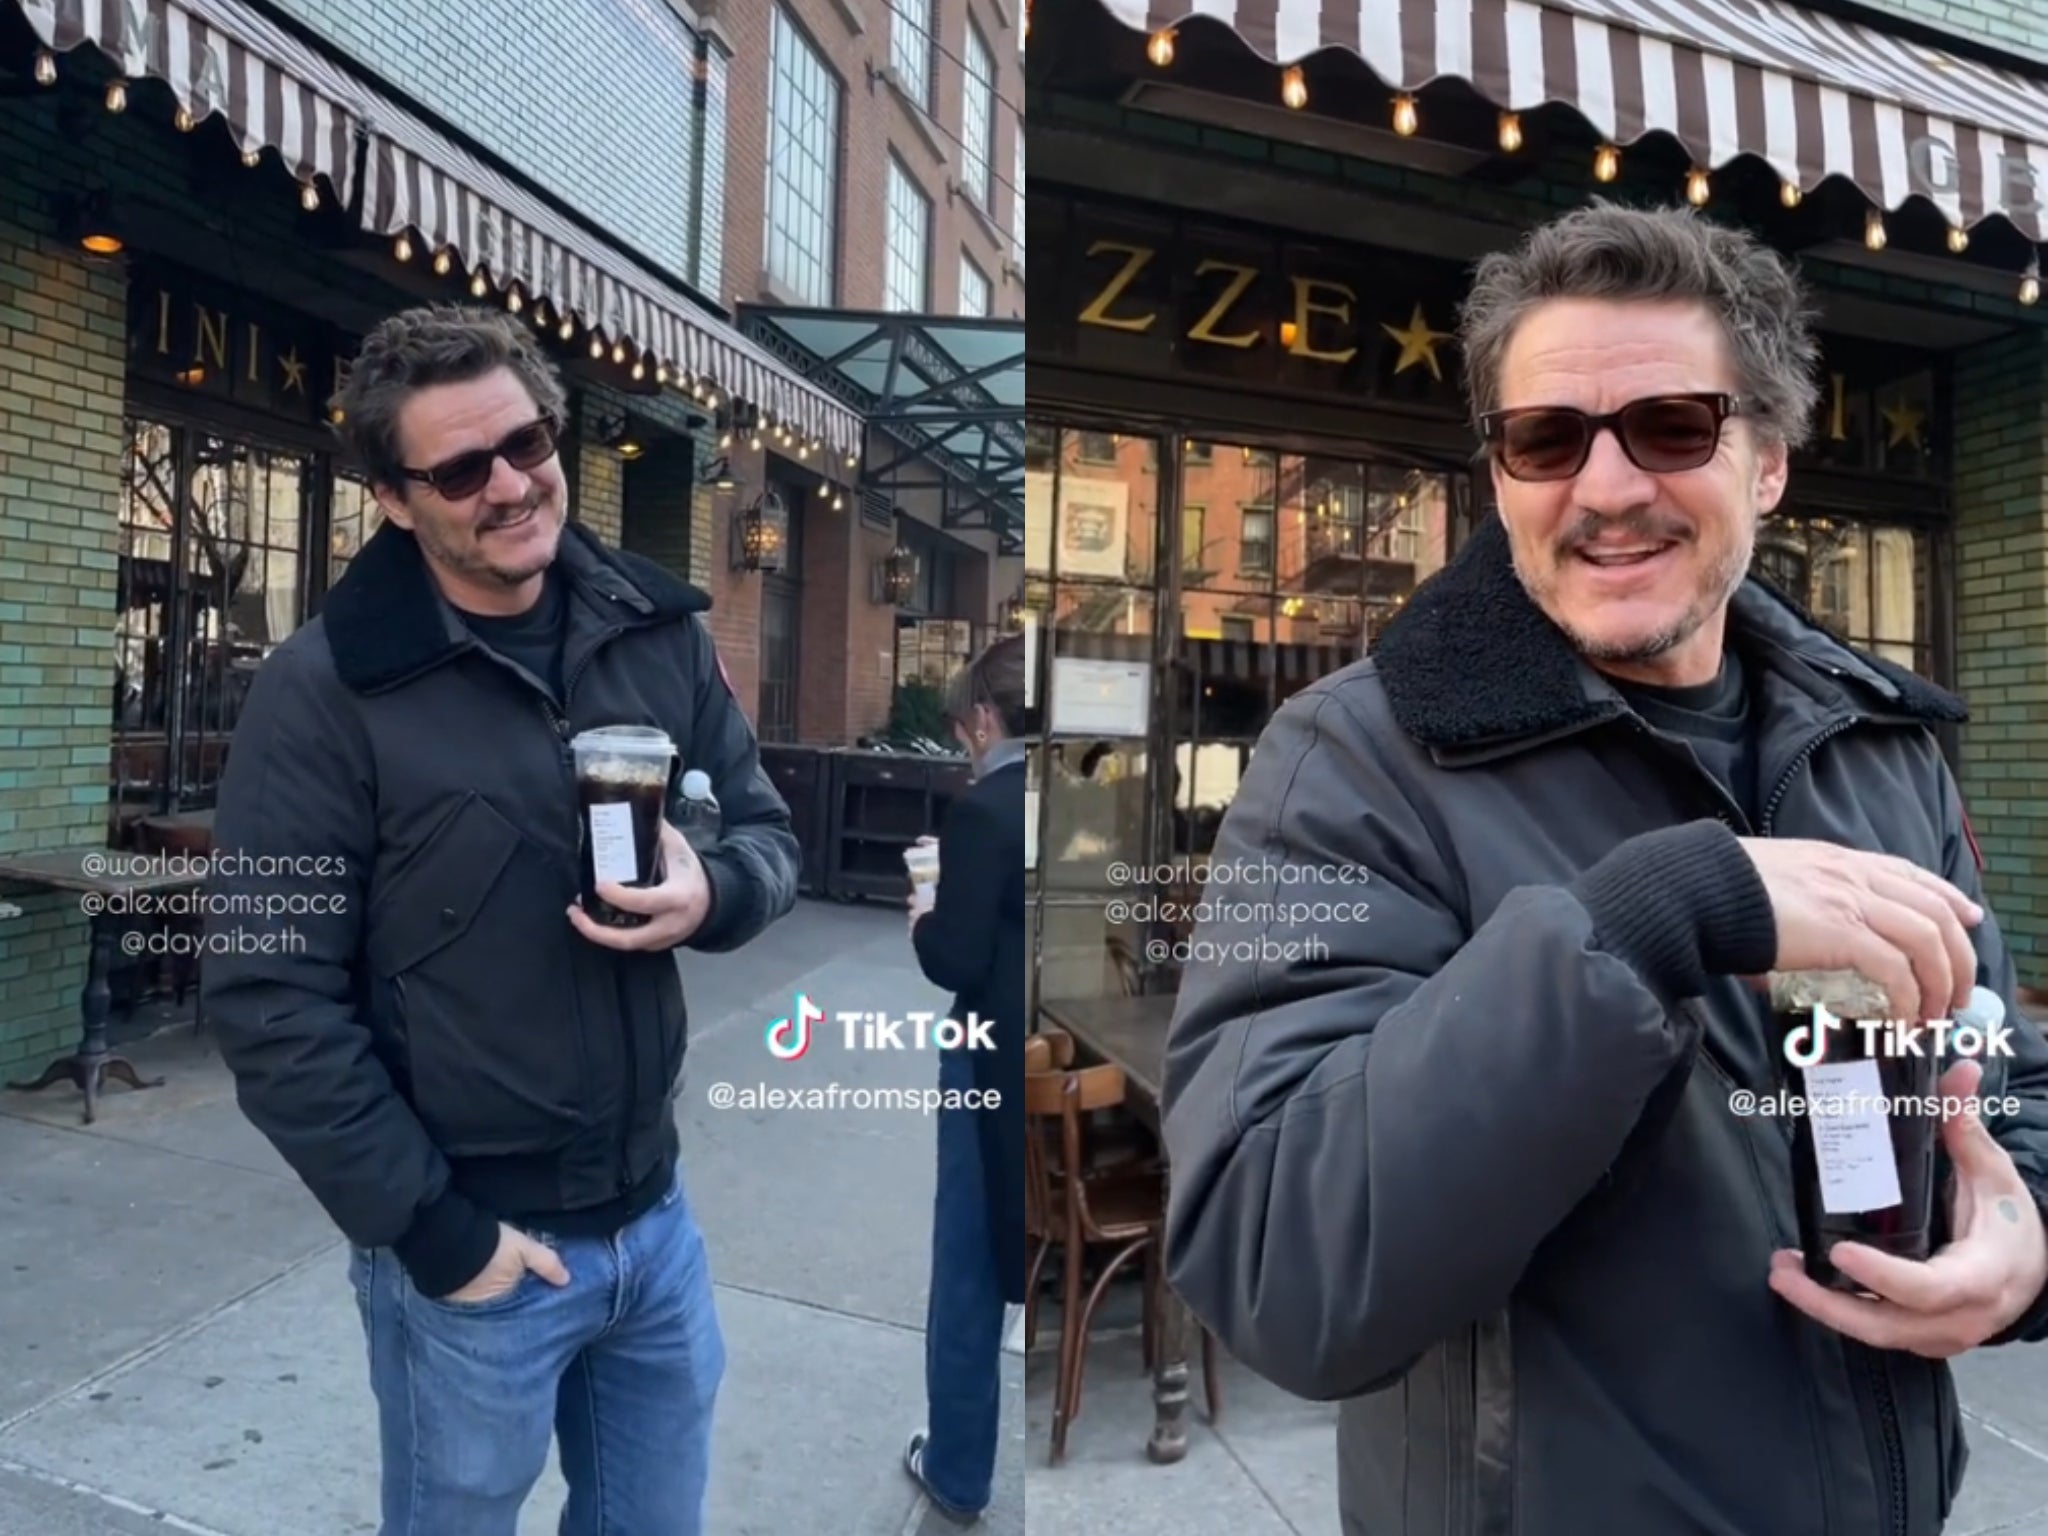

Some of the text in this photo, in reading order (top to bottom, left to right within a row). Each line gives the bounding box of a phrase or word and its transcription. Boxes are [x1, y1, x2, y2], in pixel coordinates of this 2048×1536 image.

[1909, 135, 2045, 213] GE
[157, 290, 261, 382] INI
[1077, 240, 1358, 364] ZZE
